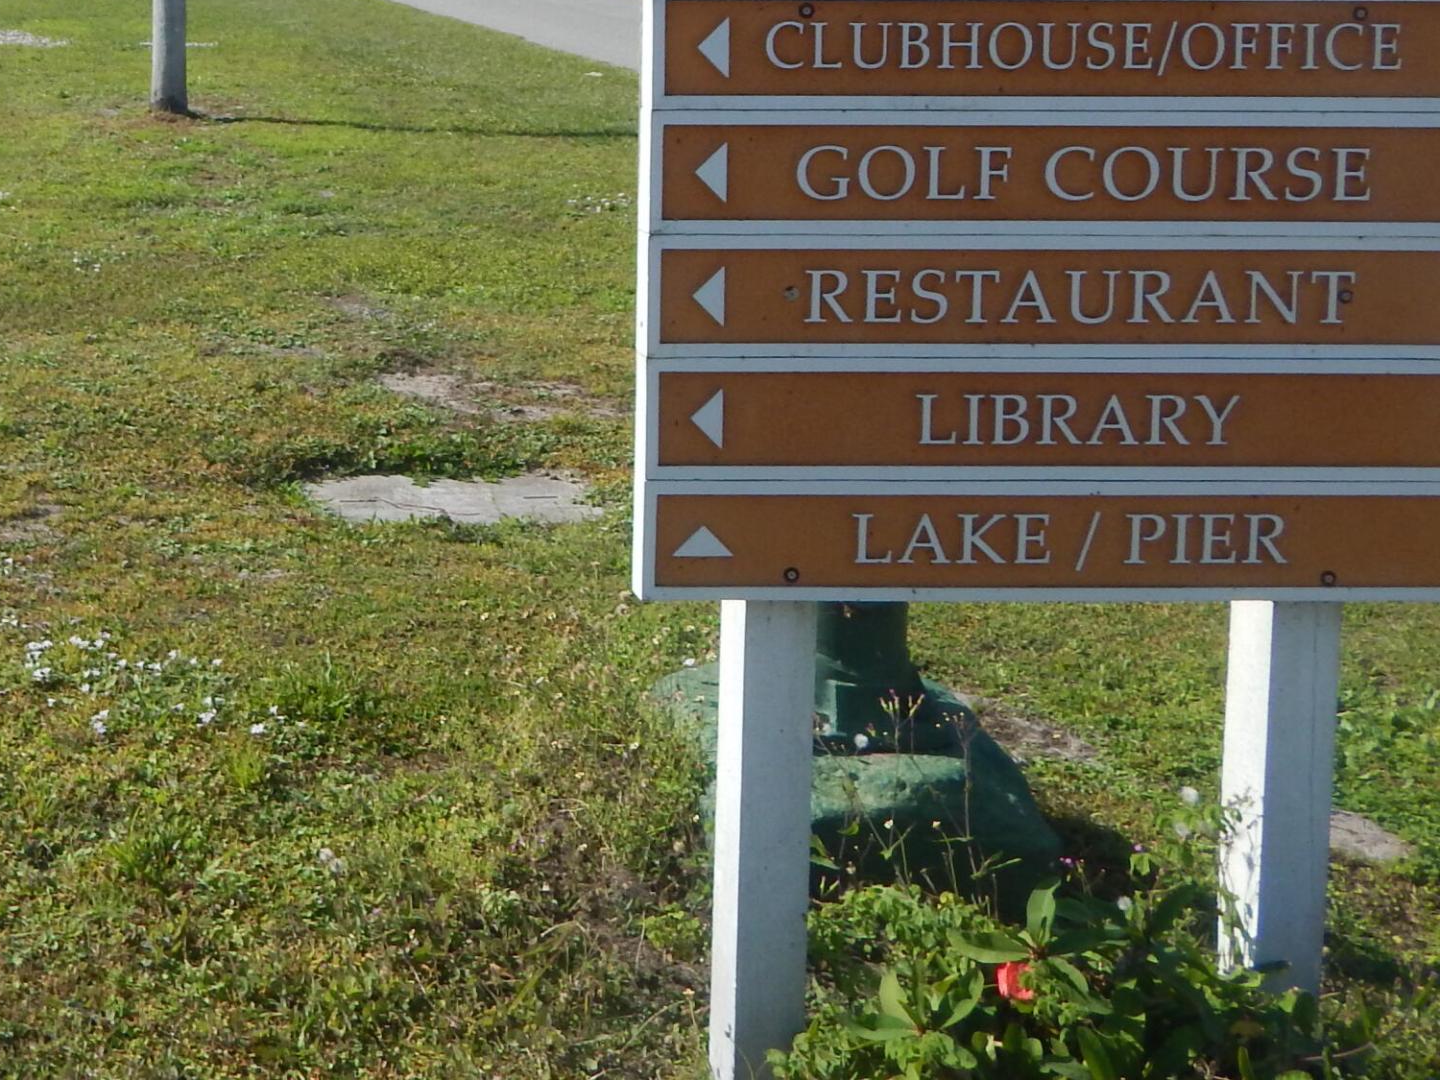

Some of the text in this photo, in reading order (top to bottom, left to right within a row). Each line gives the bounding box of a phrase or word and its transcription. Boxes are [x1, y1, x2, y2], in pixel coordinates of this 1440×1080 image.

[764, 21, 1403, 76] CLUBHOUSE/OFFICE
[795, 145, 1372, 202] GOLF COURSE
[804, 269, 1356, 325] RESTAURANT
[916, 394, 1240, 446] LIBRARY
[852, 513, 1051, 565] LAKE
[1124, 513, 1289, 565] PIER
